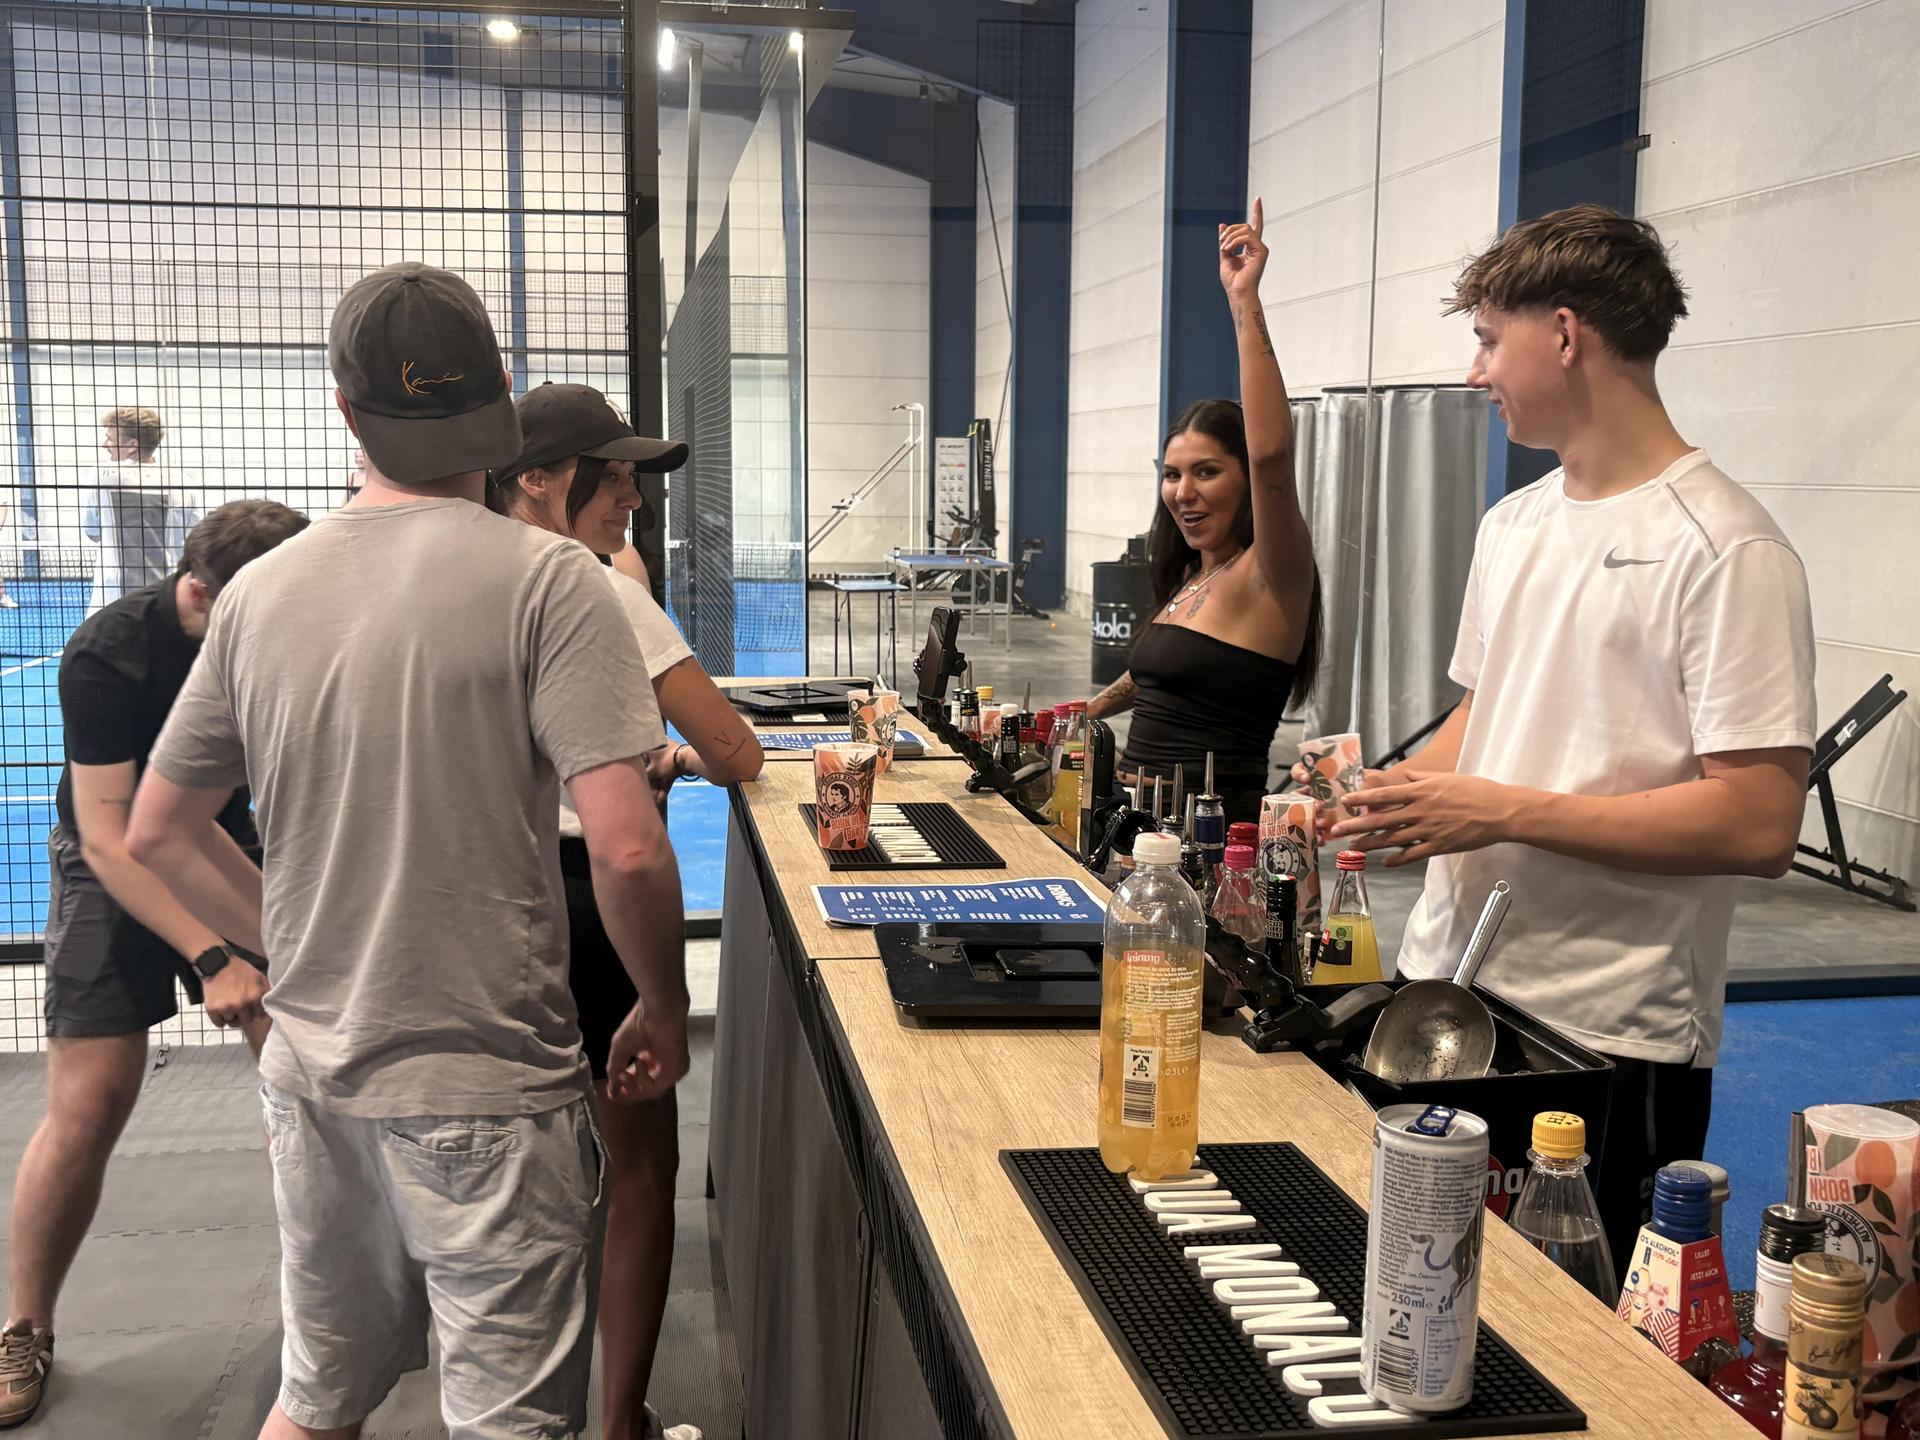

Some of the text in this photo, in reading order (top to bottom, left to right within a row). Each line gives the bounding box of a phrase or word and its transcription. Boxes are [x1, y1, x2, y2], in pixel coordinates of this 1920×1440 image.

[984, 455, 992, 491] FITNESS
[1809, 1178, 1852, 1202] BORN
[1825, 1203, 1872, 1243] AUTHENTIC
[1640, 1235, 1649, 1245] 0%
